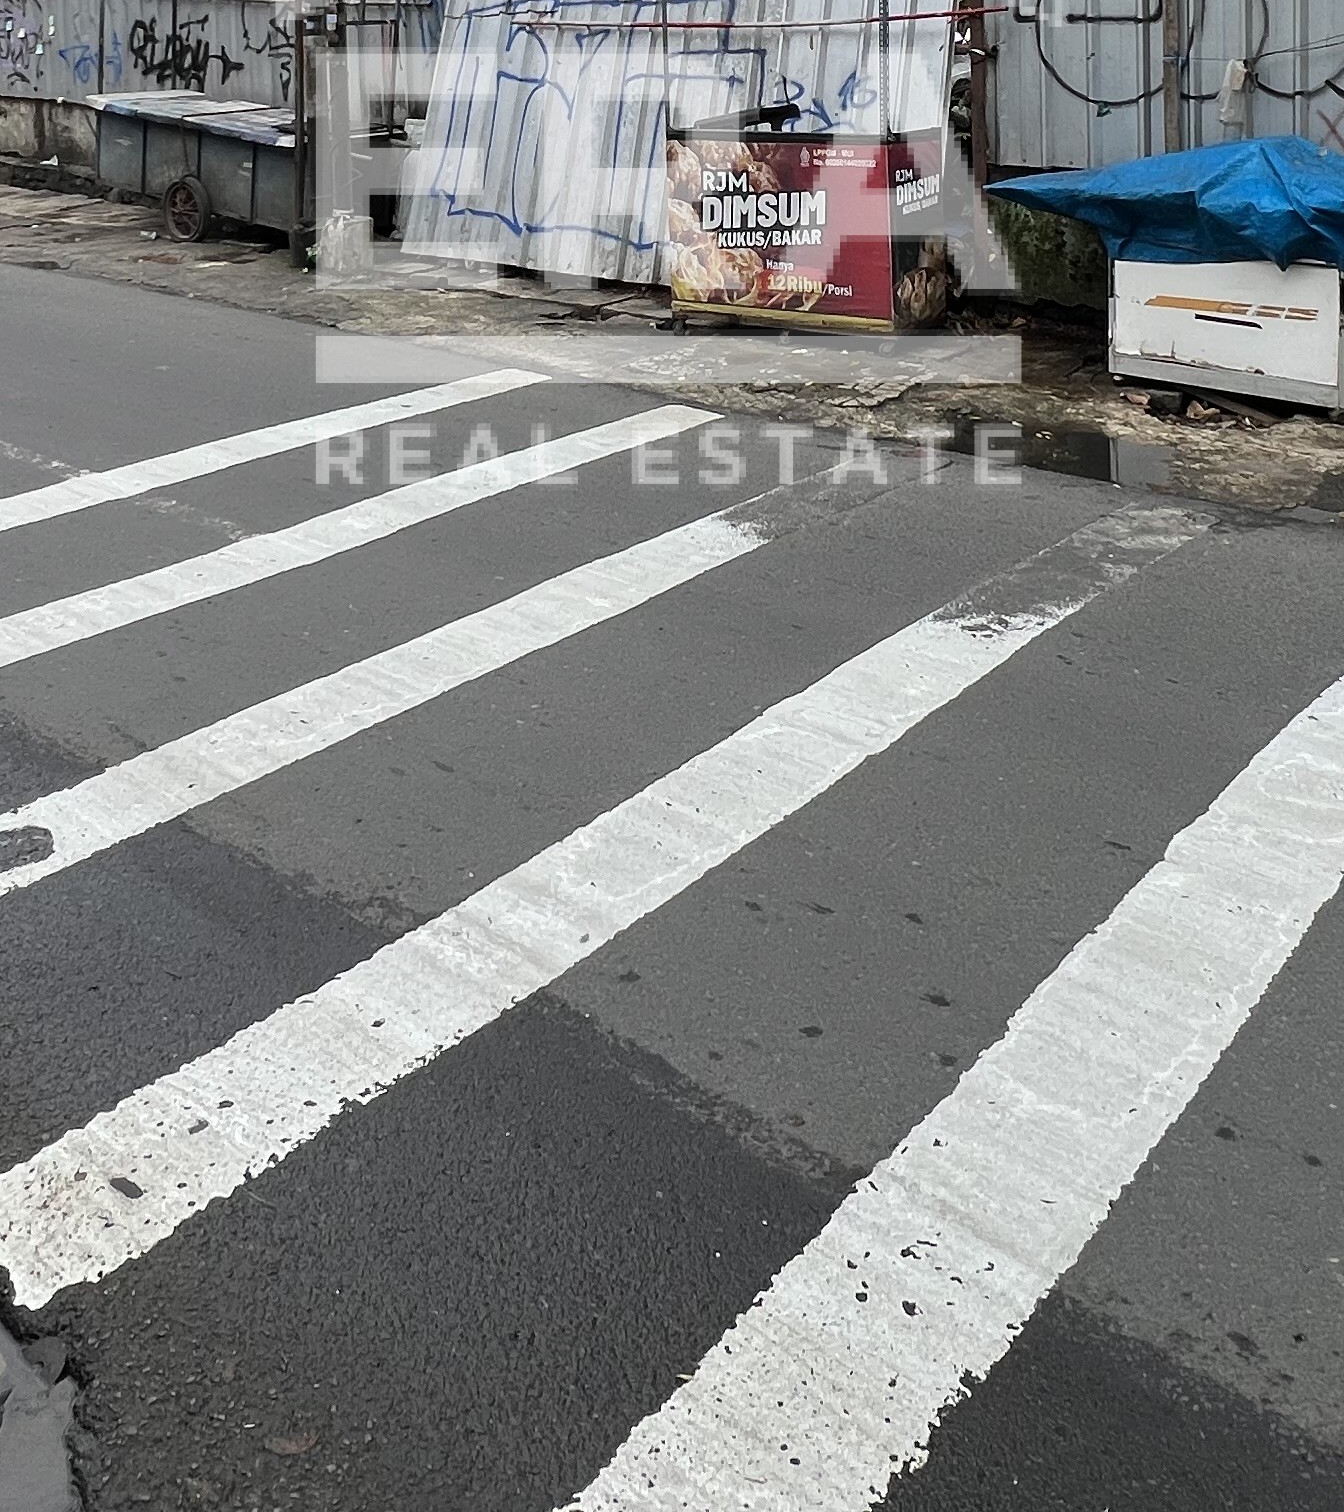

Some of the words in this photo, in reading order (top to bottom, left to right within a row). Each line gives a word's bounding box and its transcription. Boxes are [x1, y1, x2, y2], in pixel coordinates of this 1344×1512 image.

[896, 174, 940, 205] DIMSUM
[702, 190, 826, 230] DIMSUM
[718, 229, 822, 249] KUKUS/BAKAR
[765, 259, 794, 272] Hanya
